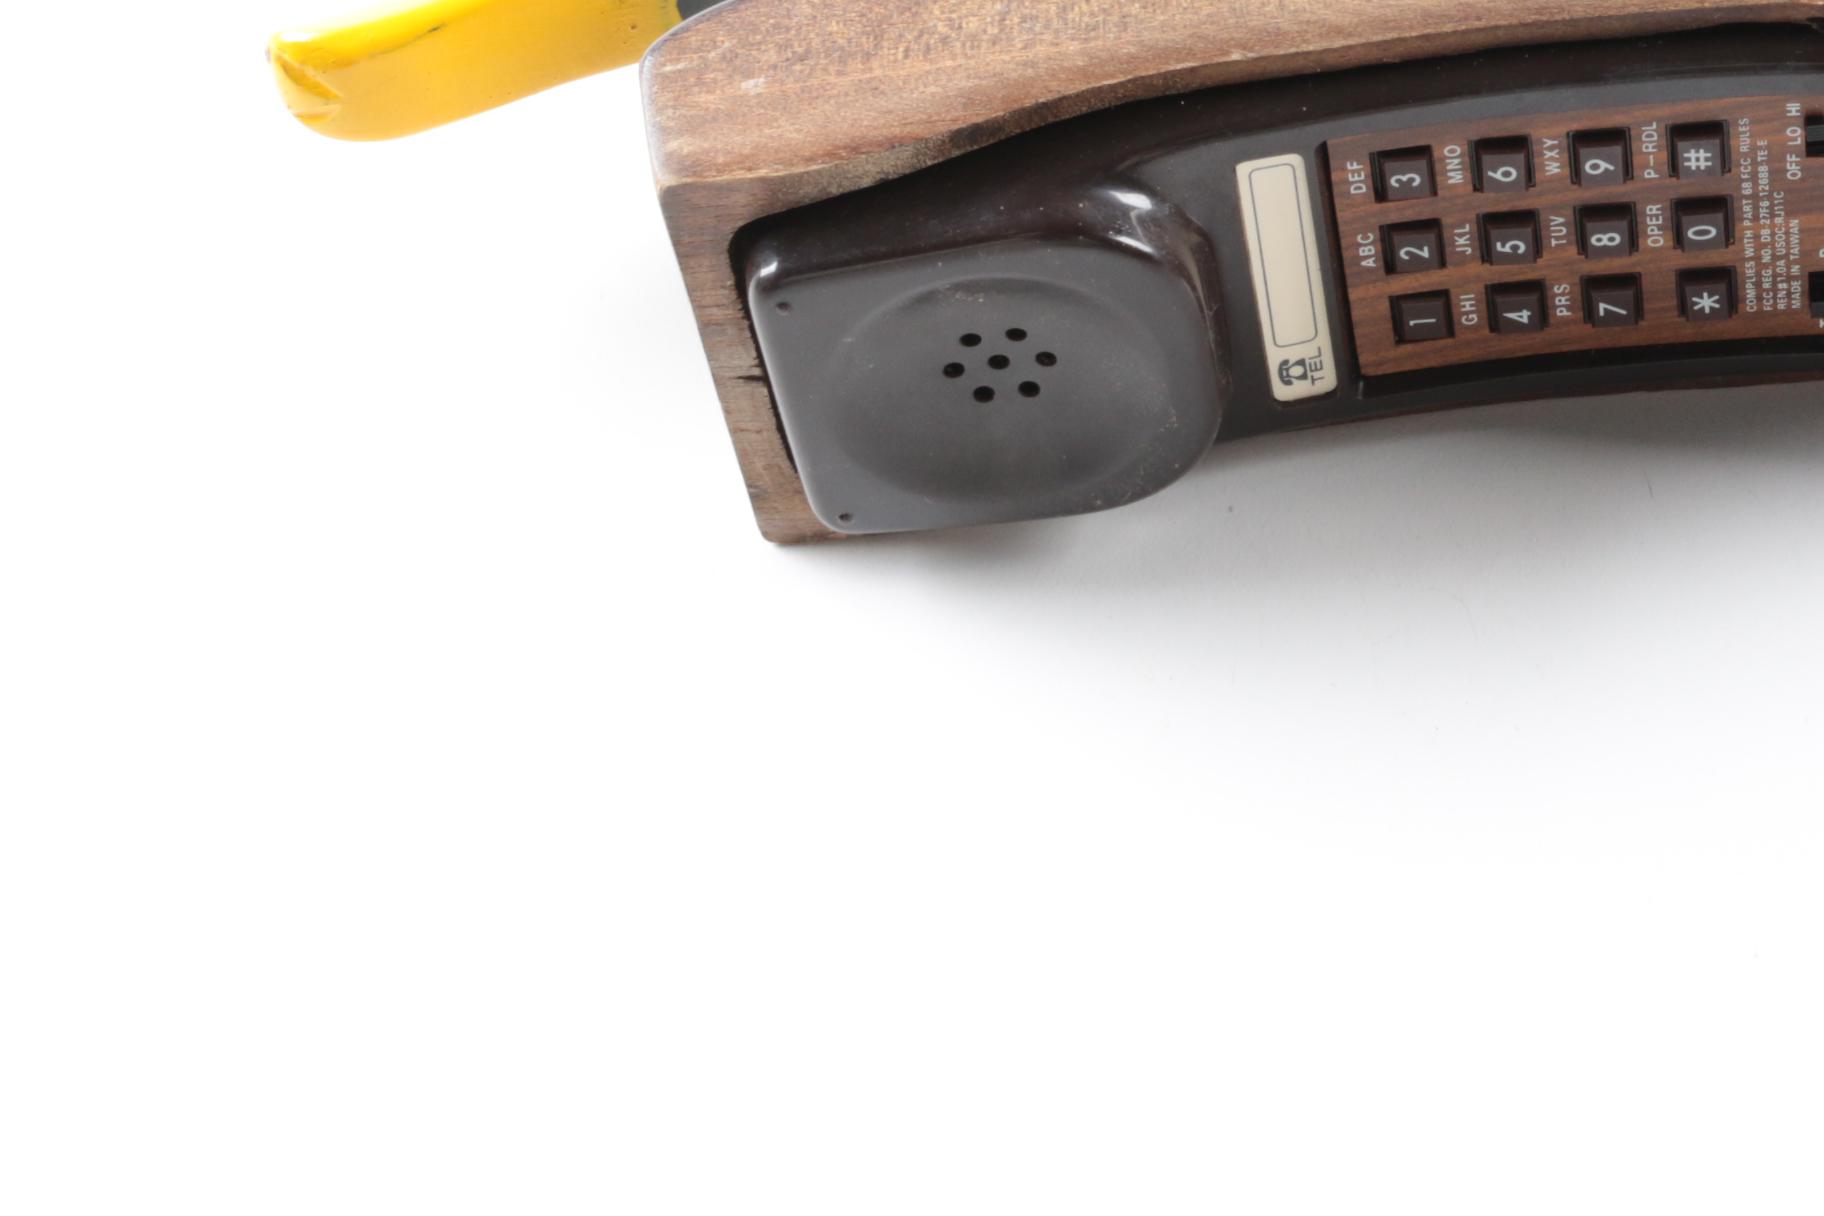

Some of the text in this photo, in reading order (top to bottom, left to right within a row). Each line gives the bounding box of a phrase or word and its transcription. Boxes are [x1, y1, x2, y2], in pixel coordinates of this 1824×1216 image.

[1786, 103, 1801, 180] OFF LO HI
[1444, 144, 1463, 184] MNO
[1543, 138, 1560, 175] WXY
[1585, 159, 1615, 175] 9
[1683, 148, 1712, 171] #
[1347, 160, 1366, 194] DEF
[1390, 172, 1421, 188] 3
[1488, 166, 1517, 182] 6
[1646, 204, 1664, 247] OPER
[1738, 118, 1757, 312] COMPLIES WITH PART 68 FCC RULES
[1455, 223, 1472, 255] JKL
[1551, 215, 1567, 247] TUV
[1591, 232, 1621, 246] 8
[1687, 225, 1717, 240] 0
[1360, 232, 1376, 267] ABC
[1400, 245, 1429, 259] 2
[1497, 239, 1526, 253] 5
[1761, 245, 1772, 263] NO.
[1789, 219, 1802, 309] MADE IN TAIWAN
[1762, 266, 1773, 289] REG.
[1461, 293, 1478, 325] GHI
[1554, 284, 1571, 316] PRS
[1599, 302, 1627, 316] 7
[1763, 291, 1773, 311] FCC
[1409, 317, 1436, 326] 1
[1503, 309, 1532, 323] 4
[1308, 346, 1323, 385] TEL
